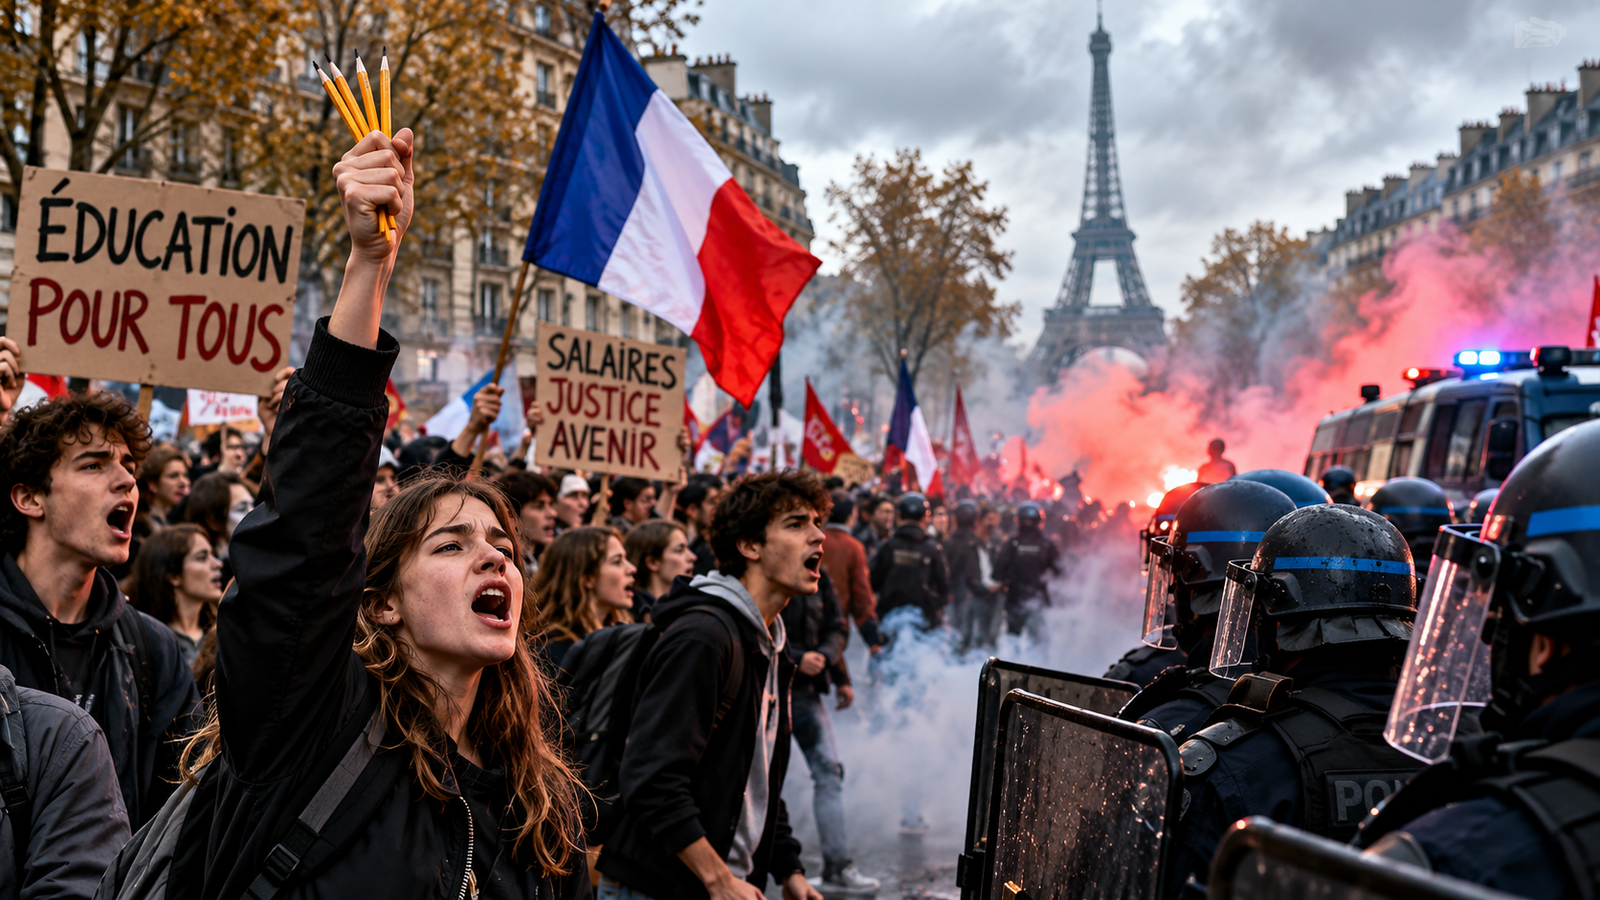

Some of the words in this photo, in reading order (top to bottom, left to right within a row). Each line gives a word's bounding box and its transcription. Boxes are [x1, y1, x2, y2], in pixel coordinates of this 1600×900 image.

[27, 277, 149, 354] POUR
[169, 295, 285, 373] TOUS
[1334, 779, 1403, 822] PO
